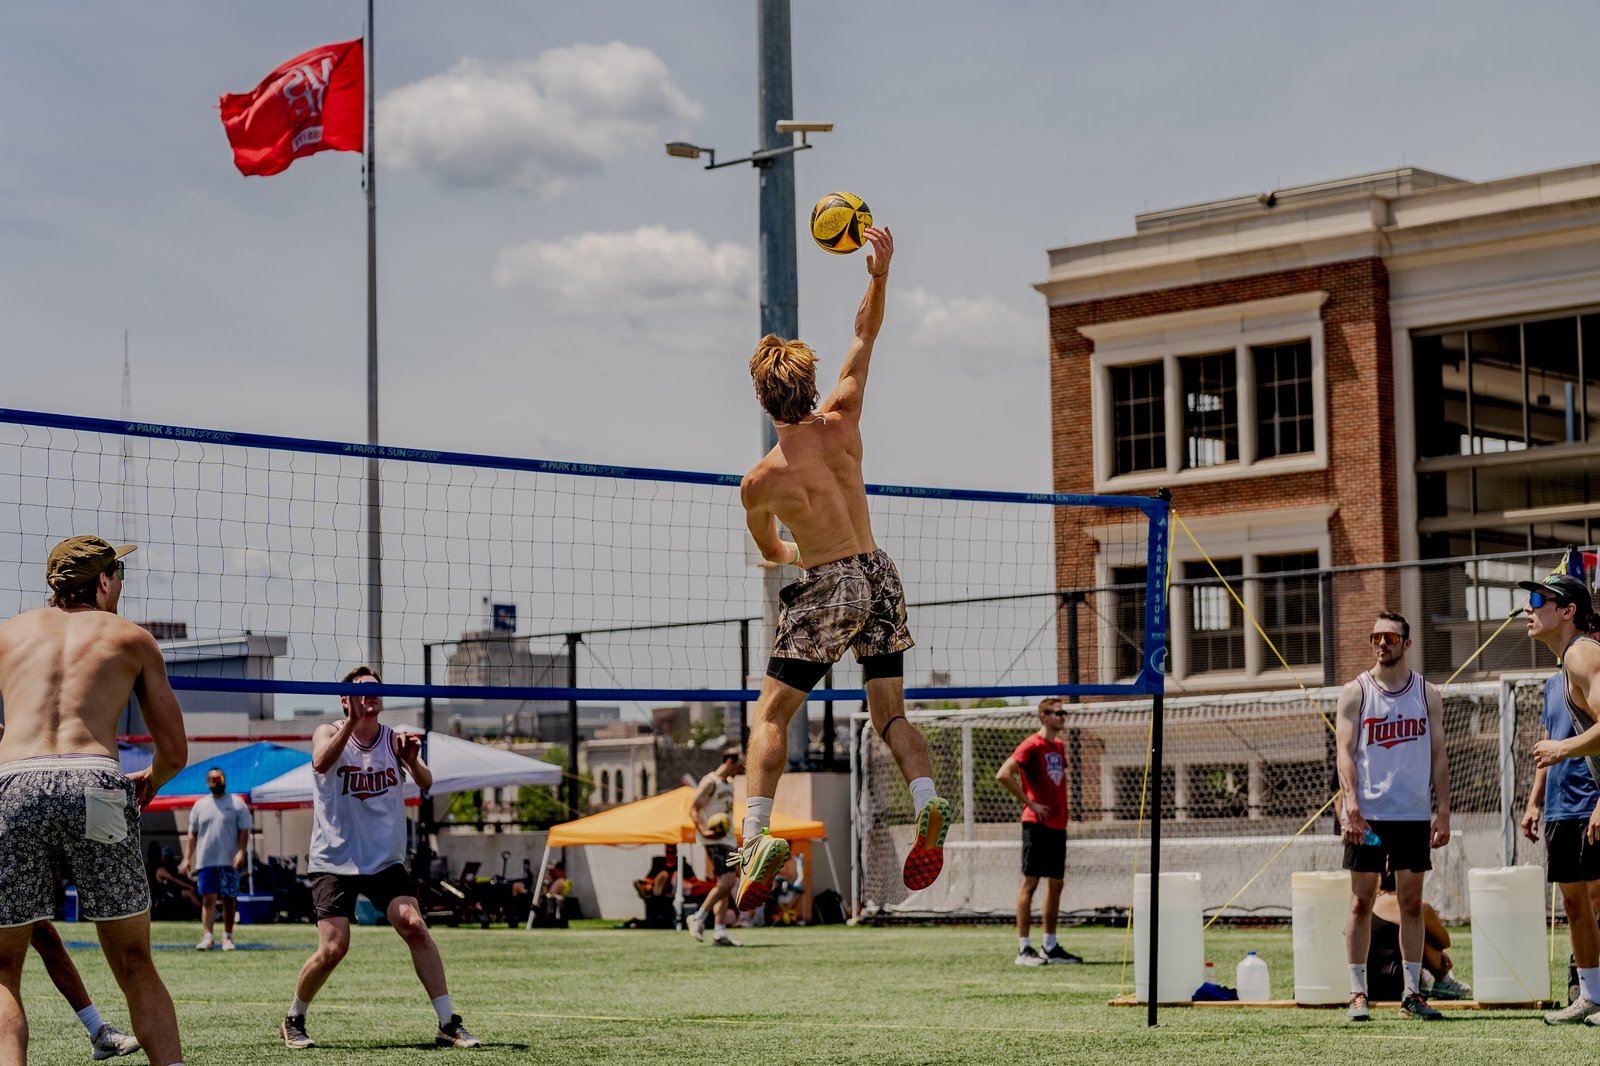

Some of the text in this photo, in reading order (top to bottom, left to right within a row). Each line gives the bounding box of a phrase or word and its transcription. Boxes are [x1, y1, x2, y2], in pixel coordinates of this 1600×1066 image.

[137, 423, 162, 435] PARK
[165, 427, 173, 436] &
[353, 444, 376, 455] PARK
[379, 446, 385, 455] &
[548, 461, 570, 471] PARK
[571, 463, 578, 472] &
[885, 485, 904, 494] PARK
[1155, 580, 1161, 589] &
[1362, 713, 1427, 748] Twins
[336, 765, 398, 798] Twins
